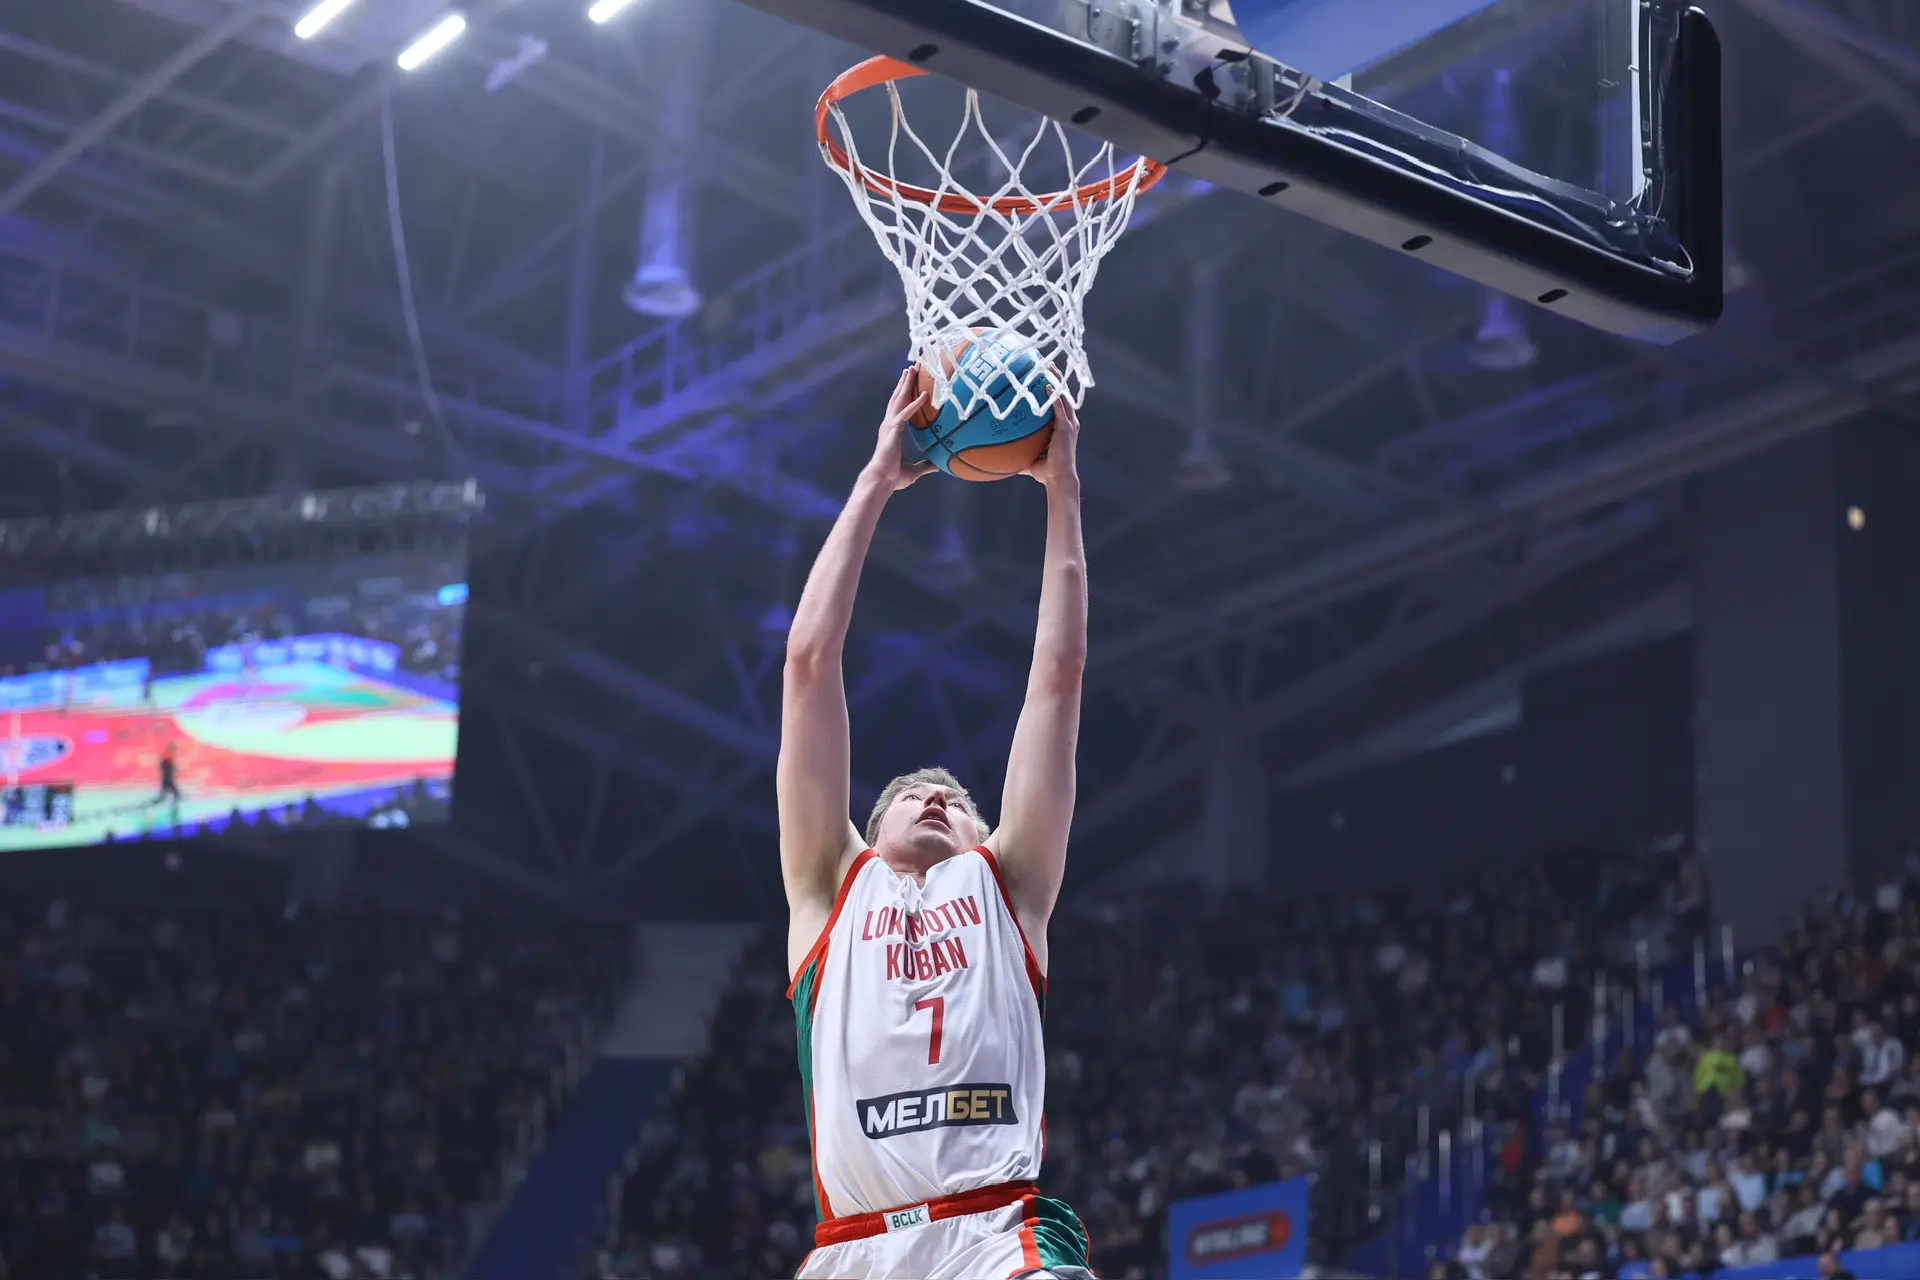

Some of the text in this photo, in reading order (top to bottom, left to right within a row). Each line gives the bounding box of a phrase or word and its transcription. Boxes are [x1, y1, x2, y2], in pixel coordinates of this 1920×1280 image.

[862, 896, 981, 942] LOKMOTIV
[887, 937, 968, 980] KUBAN
[915, 996, 944, 1065] 7
[866, 1090, 1008, 1133] МЕЛБЕТ
[891, 1209, 923, 1228] BCLK
